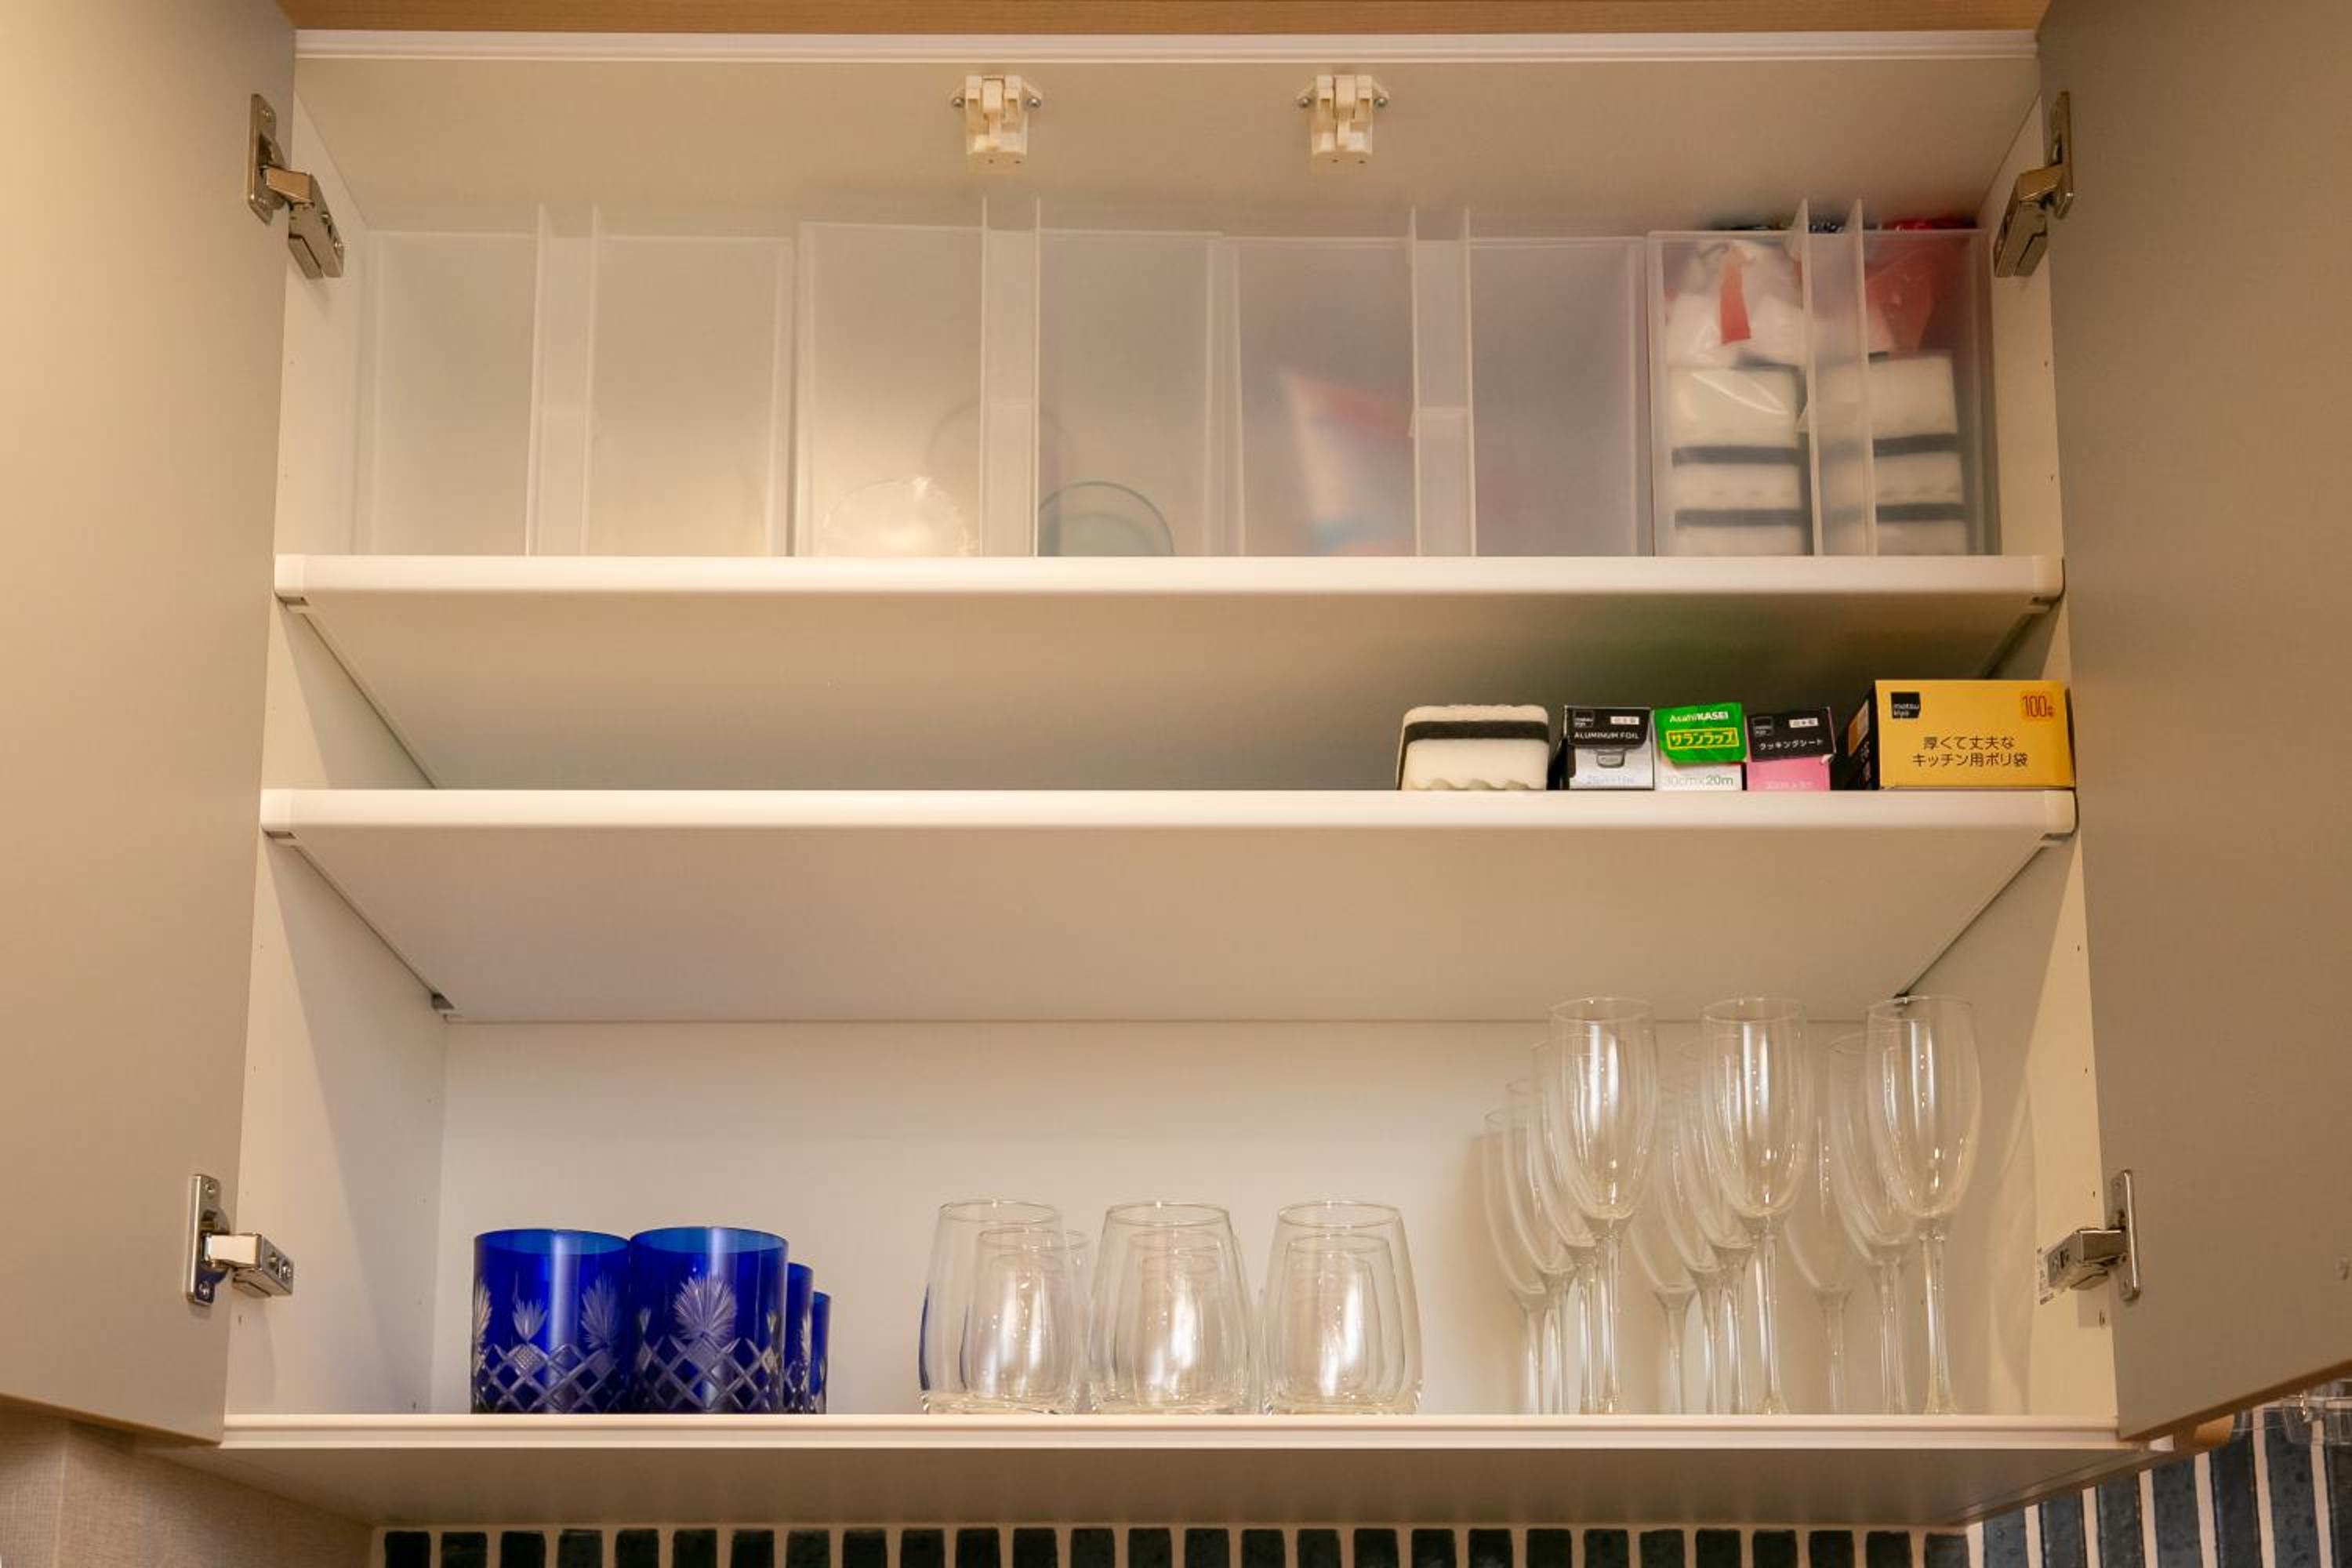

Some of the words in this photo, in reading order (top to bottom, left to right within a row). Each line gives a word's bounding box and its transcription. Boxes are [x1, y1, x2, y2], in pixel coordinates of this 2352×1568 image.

[1670, 731, 1736, 746] サランラップ
[1923, 735, 2016, 750] 厚くて丈夫な
[1912, 753, 2028, 768] キッチン用ポリ袋
